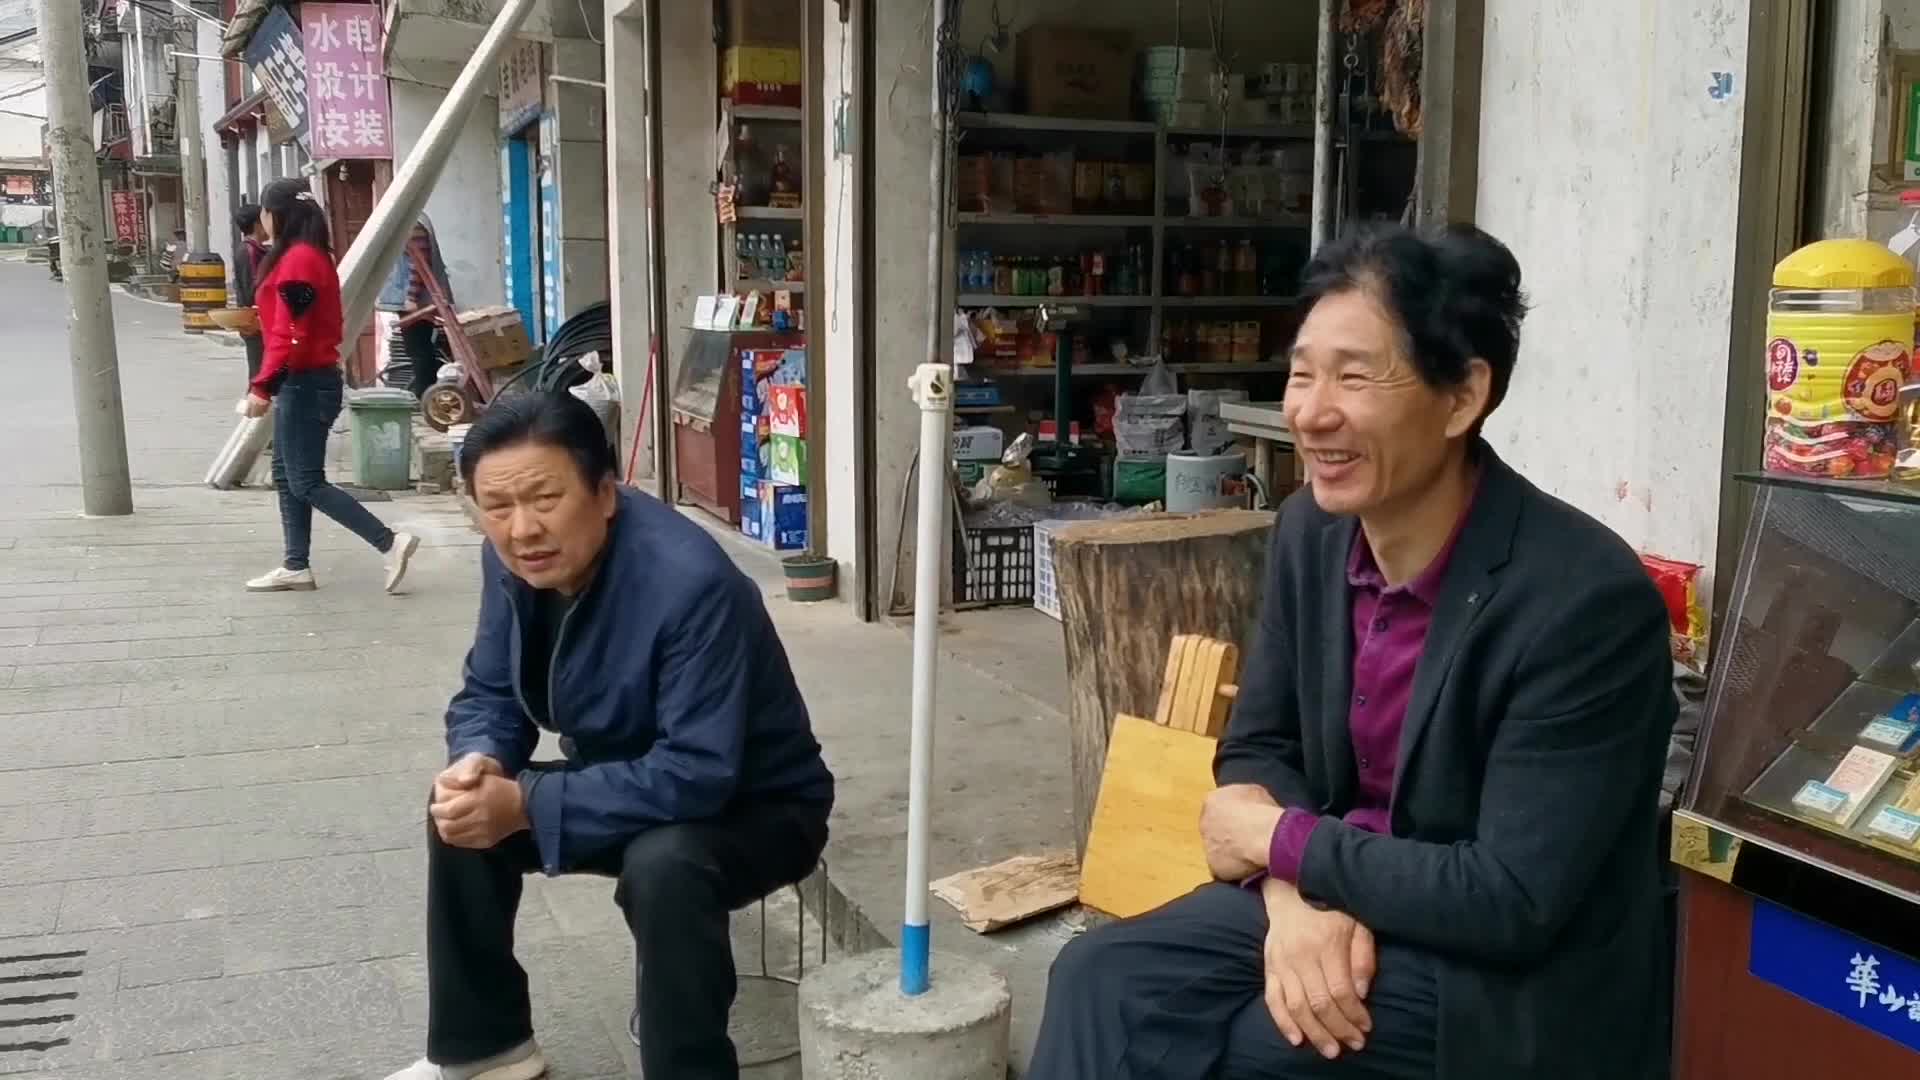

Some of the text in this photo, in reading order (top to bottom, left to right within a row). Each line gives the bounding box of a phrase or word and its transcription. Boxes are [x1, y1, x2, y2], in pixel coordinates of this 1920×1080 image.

[309, 13, 377, 53] 水电
[312, 61, 380, 101] 设计
[316, 107, 385, 149] 安装
